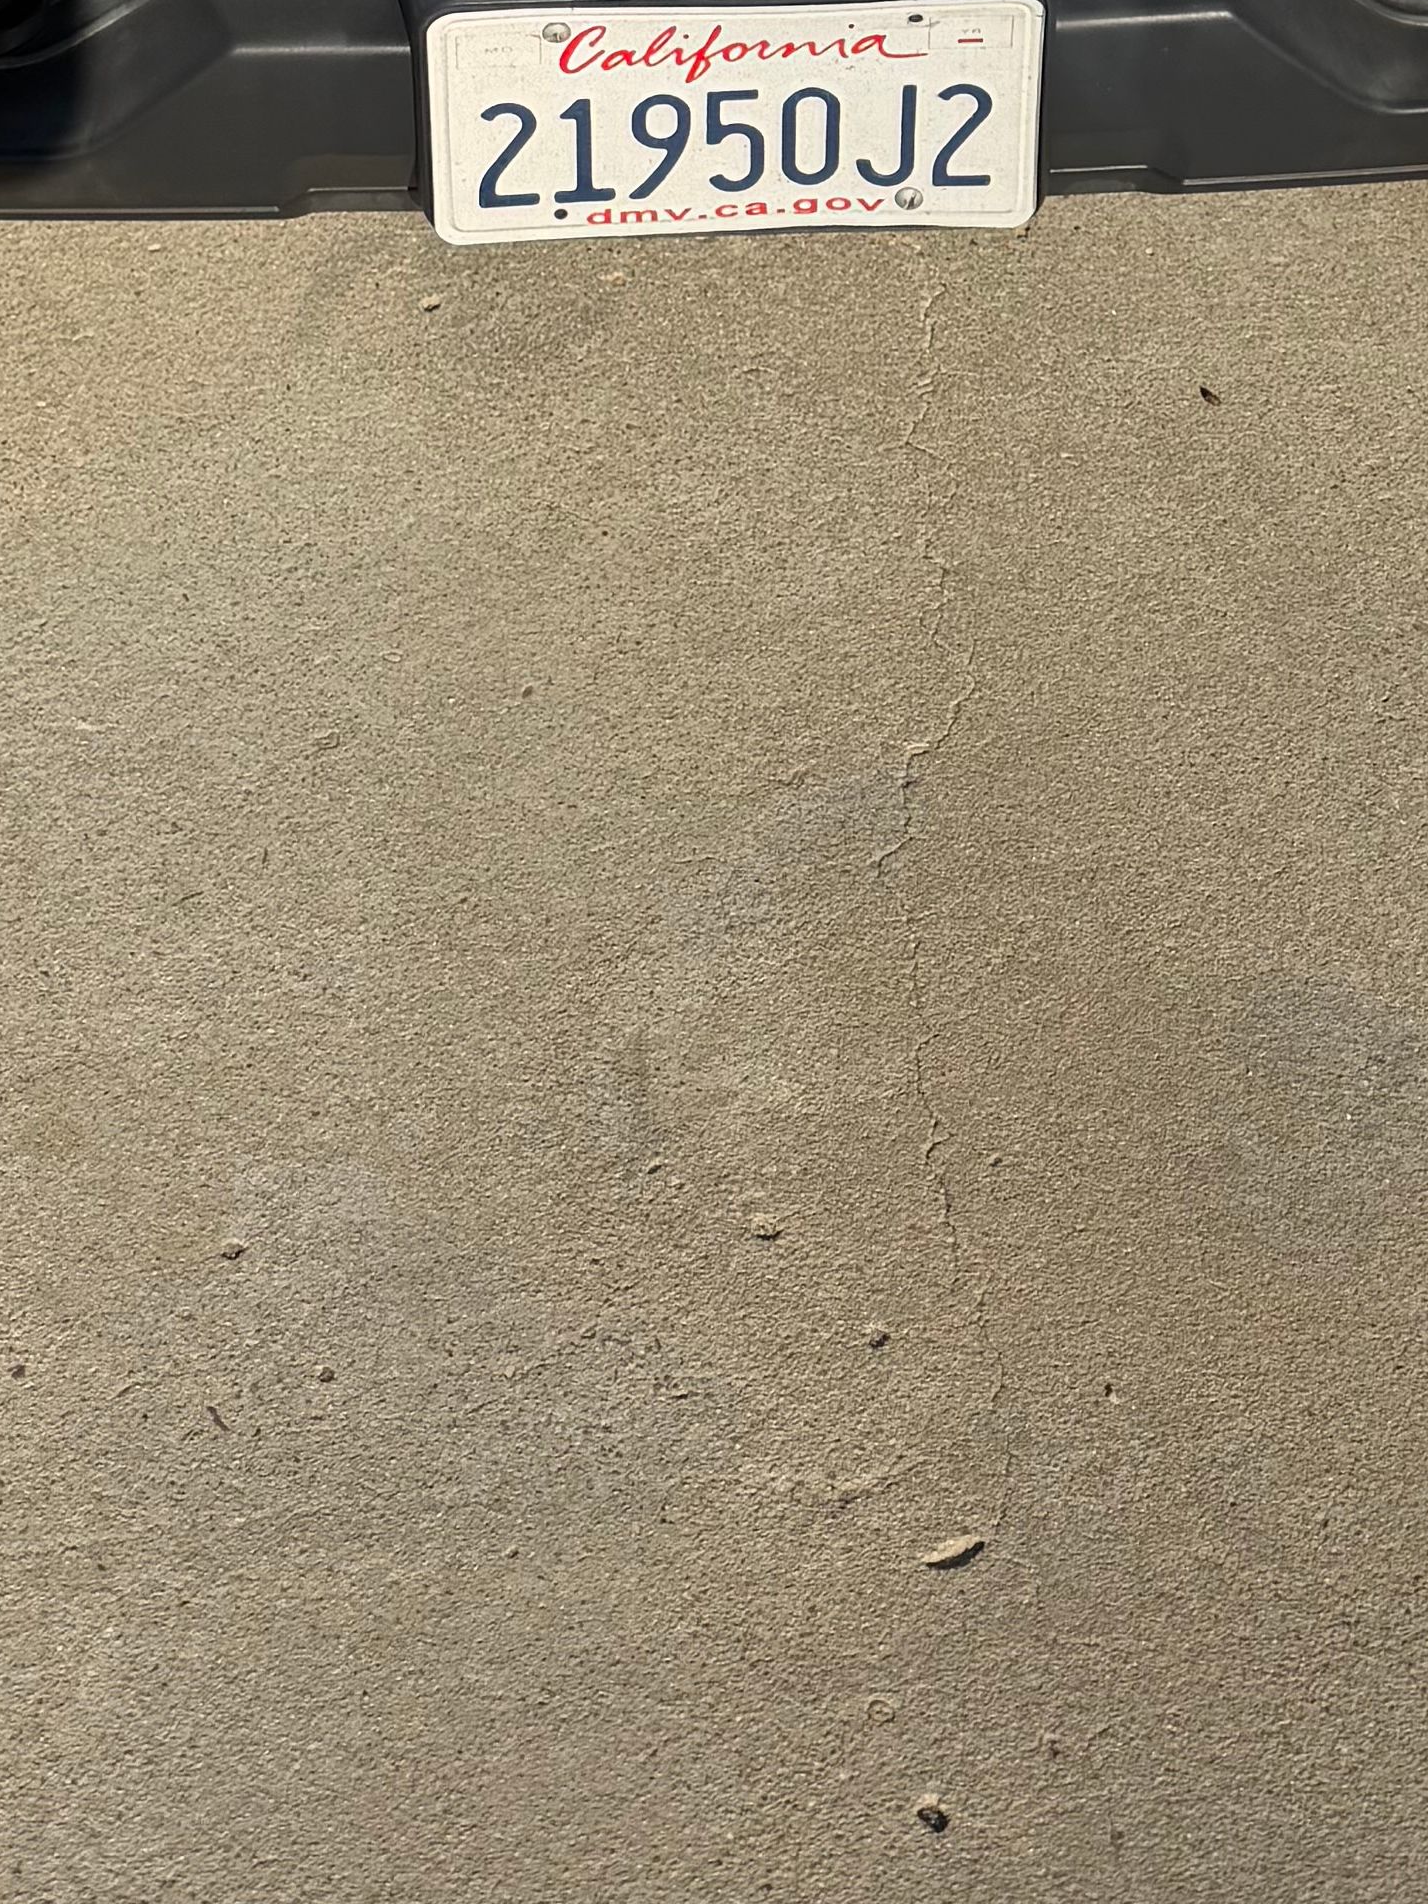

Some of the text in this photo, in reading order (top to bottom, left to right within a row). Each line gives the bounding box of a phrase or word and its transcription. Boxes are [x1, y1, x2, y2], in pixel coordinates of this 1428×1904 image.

[557, 24, 929, 84] California
[478, 84, 993, 209] 21950J2
[586, 192, 885, 226] dmv.ca.gov
